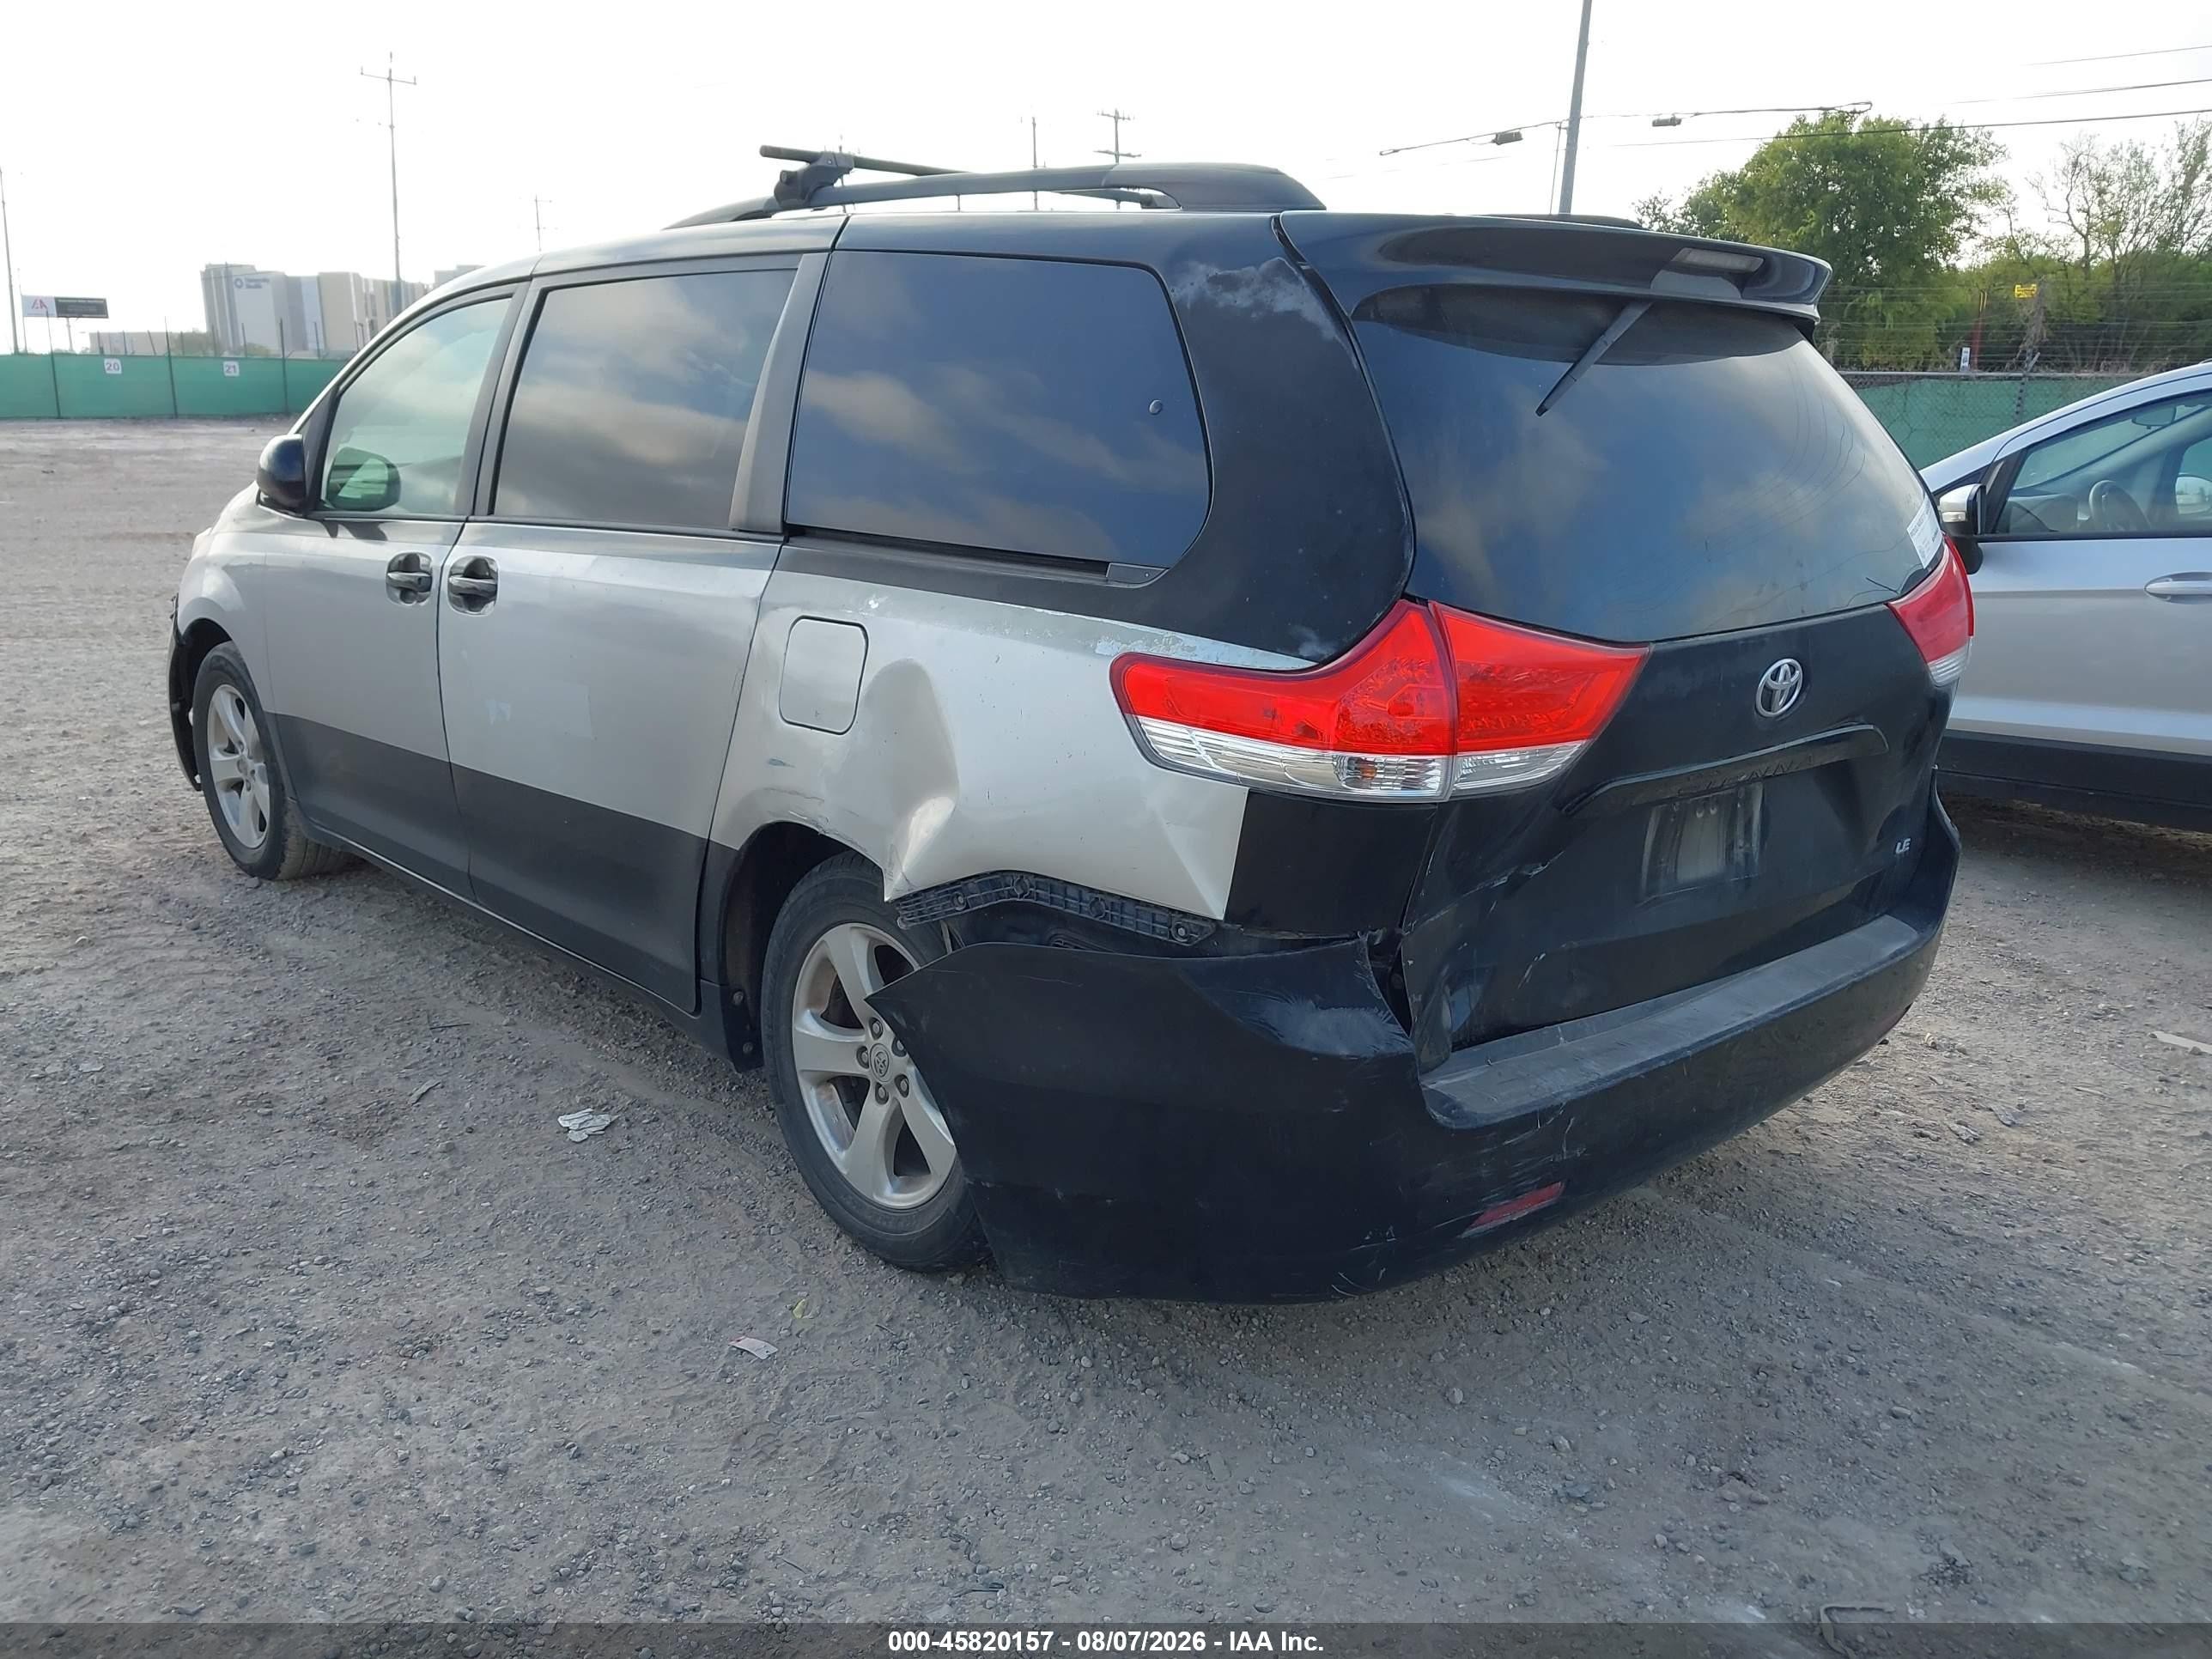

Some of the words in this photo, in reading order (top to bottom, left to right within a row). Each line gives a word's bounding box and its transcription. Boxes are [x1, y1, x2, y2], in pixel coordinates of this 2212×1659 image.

[106, 362, 120, 372] 20
[225, 364, 237, 374] 21
[1895, 838, 1911, 854] LE
